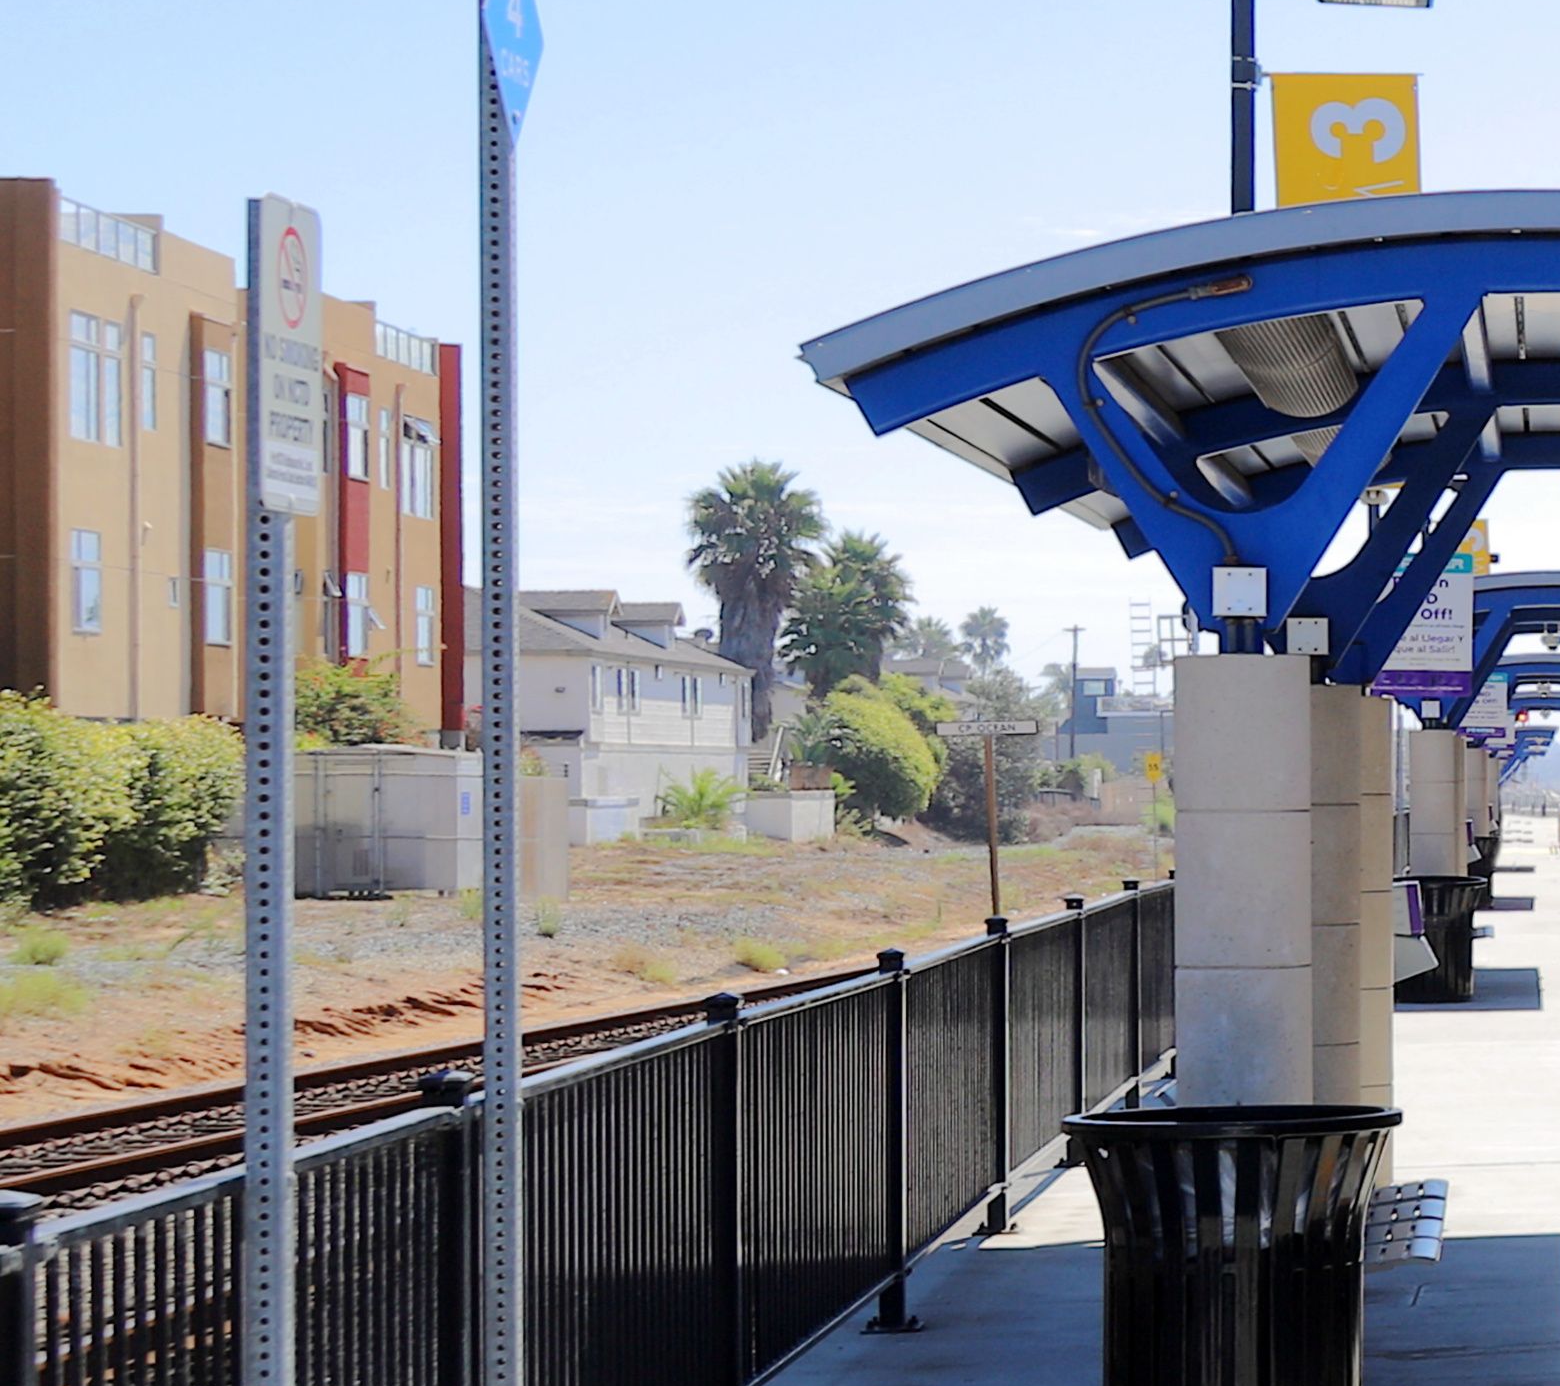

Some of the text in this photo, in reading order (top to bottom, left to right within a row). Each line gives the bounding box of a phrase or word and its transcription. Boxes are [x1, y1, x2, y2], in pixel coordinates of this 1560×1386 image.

[501, 48, 531, 88] CARS
[1311, 97, 1407, 163] 3
[1421, 608, 1453, 620] Off!
[958, 723, 1016, 733] CP OCEAN
